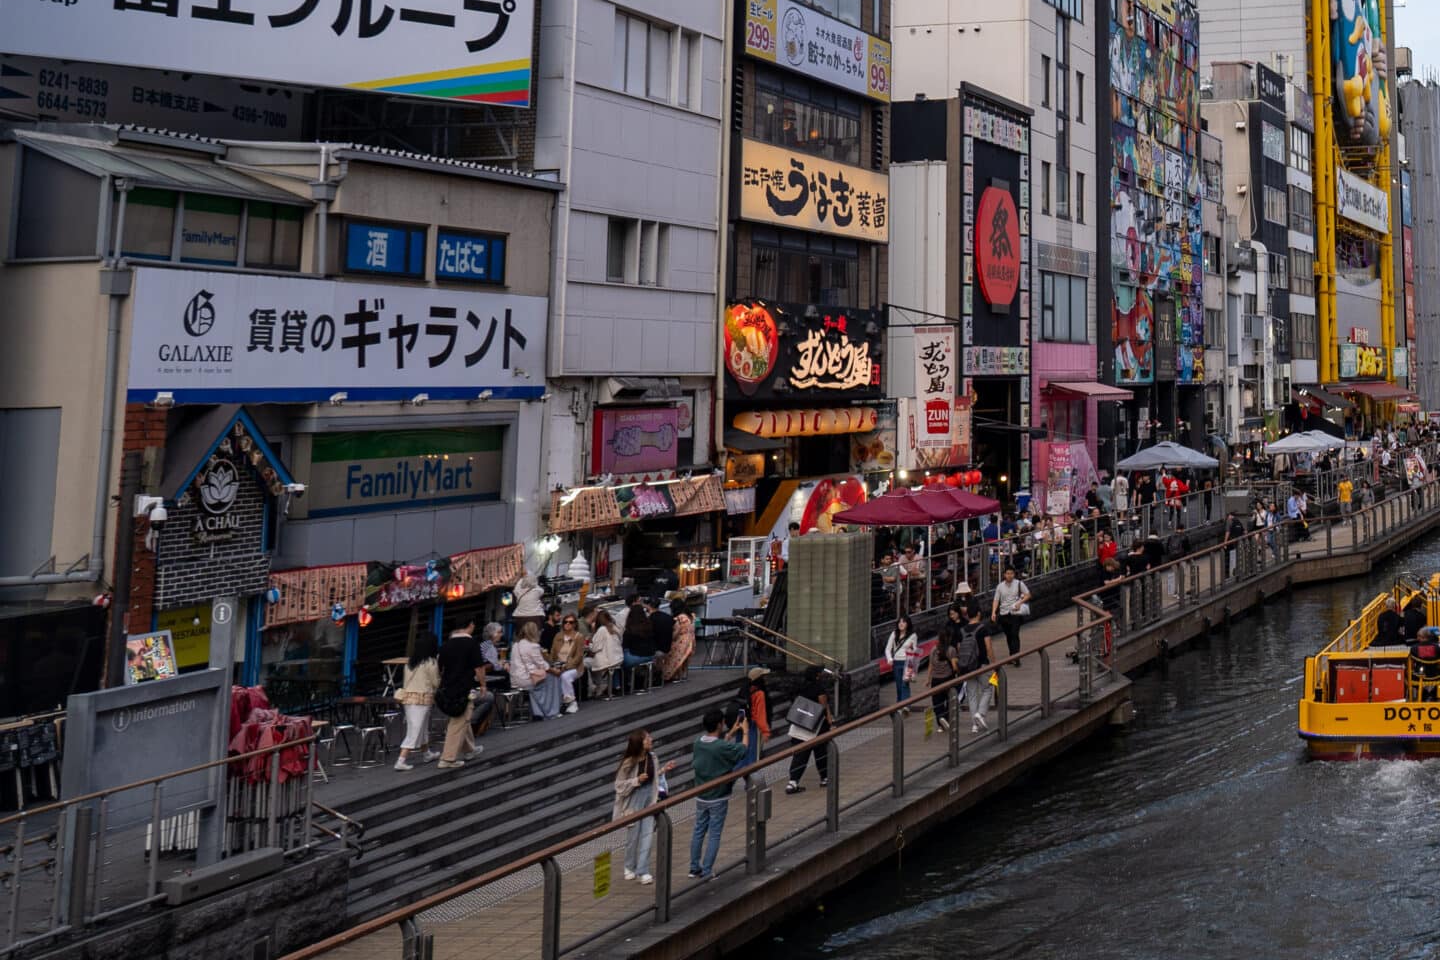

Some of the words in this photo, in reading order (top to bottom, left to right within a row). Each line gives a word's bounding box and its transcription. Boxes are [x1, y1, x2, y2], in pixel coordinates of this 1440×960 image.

[750, 1, 774, 20] 生ビール
[747, 21, 770, 51] 299
[807, 40, 865, 79] 餃子のかっちゃん
[39, 68, 109, 97] 6241-8839
[36, 92, 107, 118] 6644-5573
[765, 157, 855, 228] うなぎ
[182, 228, 239, 249] FamilyMart
[366, 230, 389, 270] 酒
[438, 239, 486, 277] たばこ
[247, 298, 528, 371] 賃貸のギャラント
[158, 344, 233, 362] GALAXIE
[927, 409, 949, 421] ZUN
[346, 459, 473, 500] FamilyMart
[1407, 723, 1433, 732] 大阪
